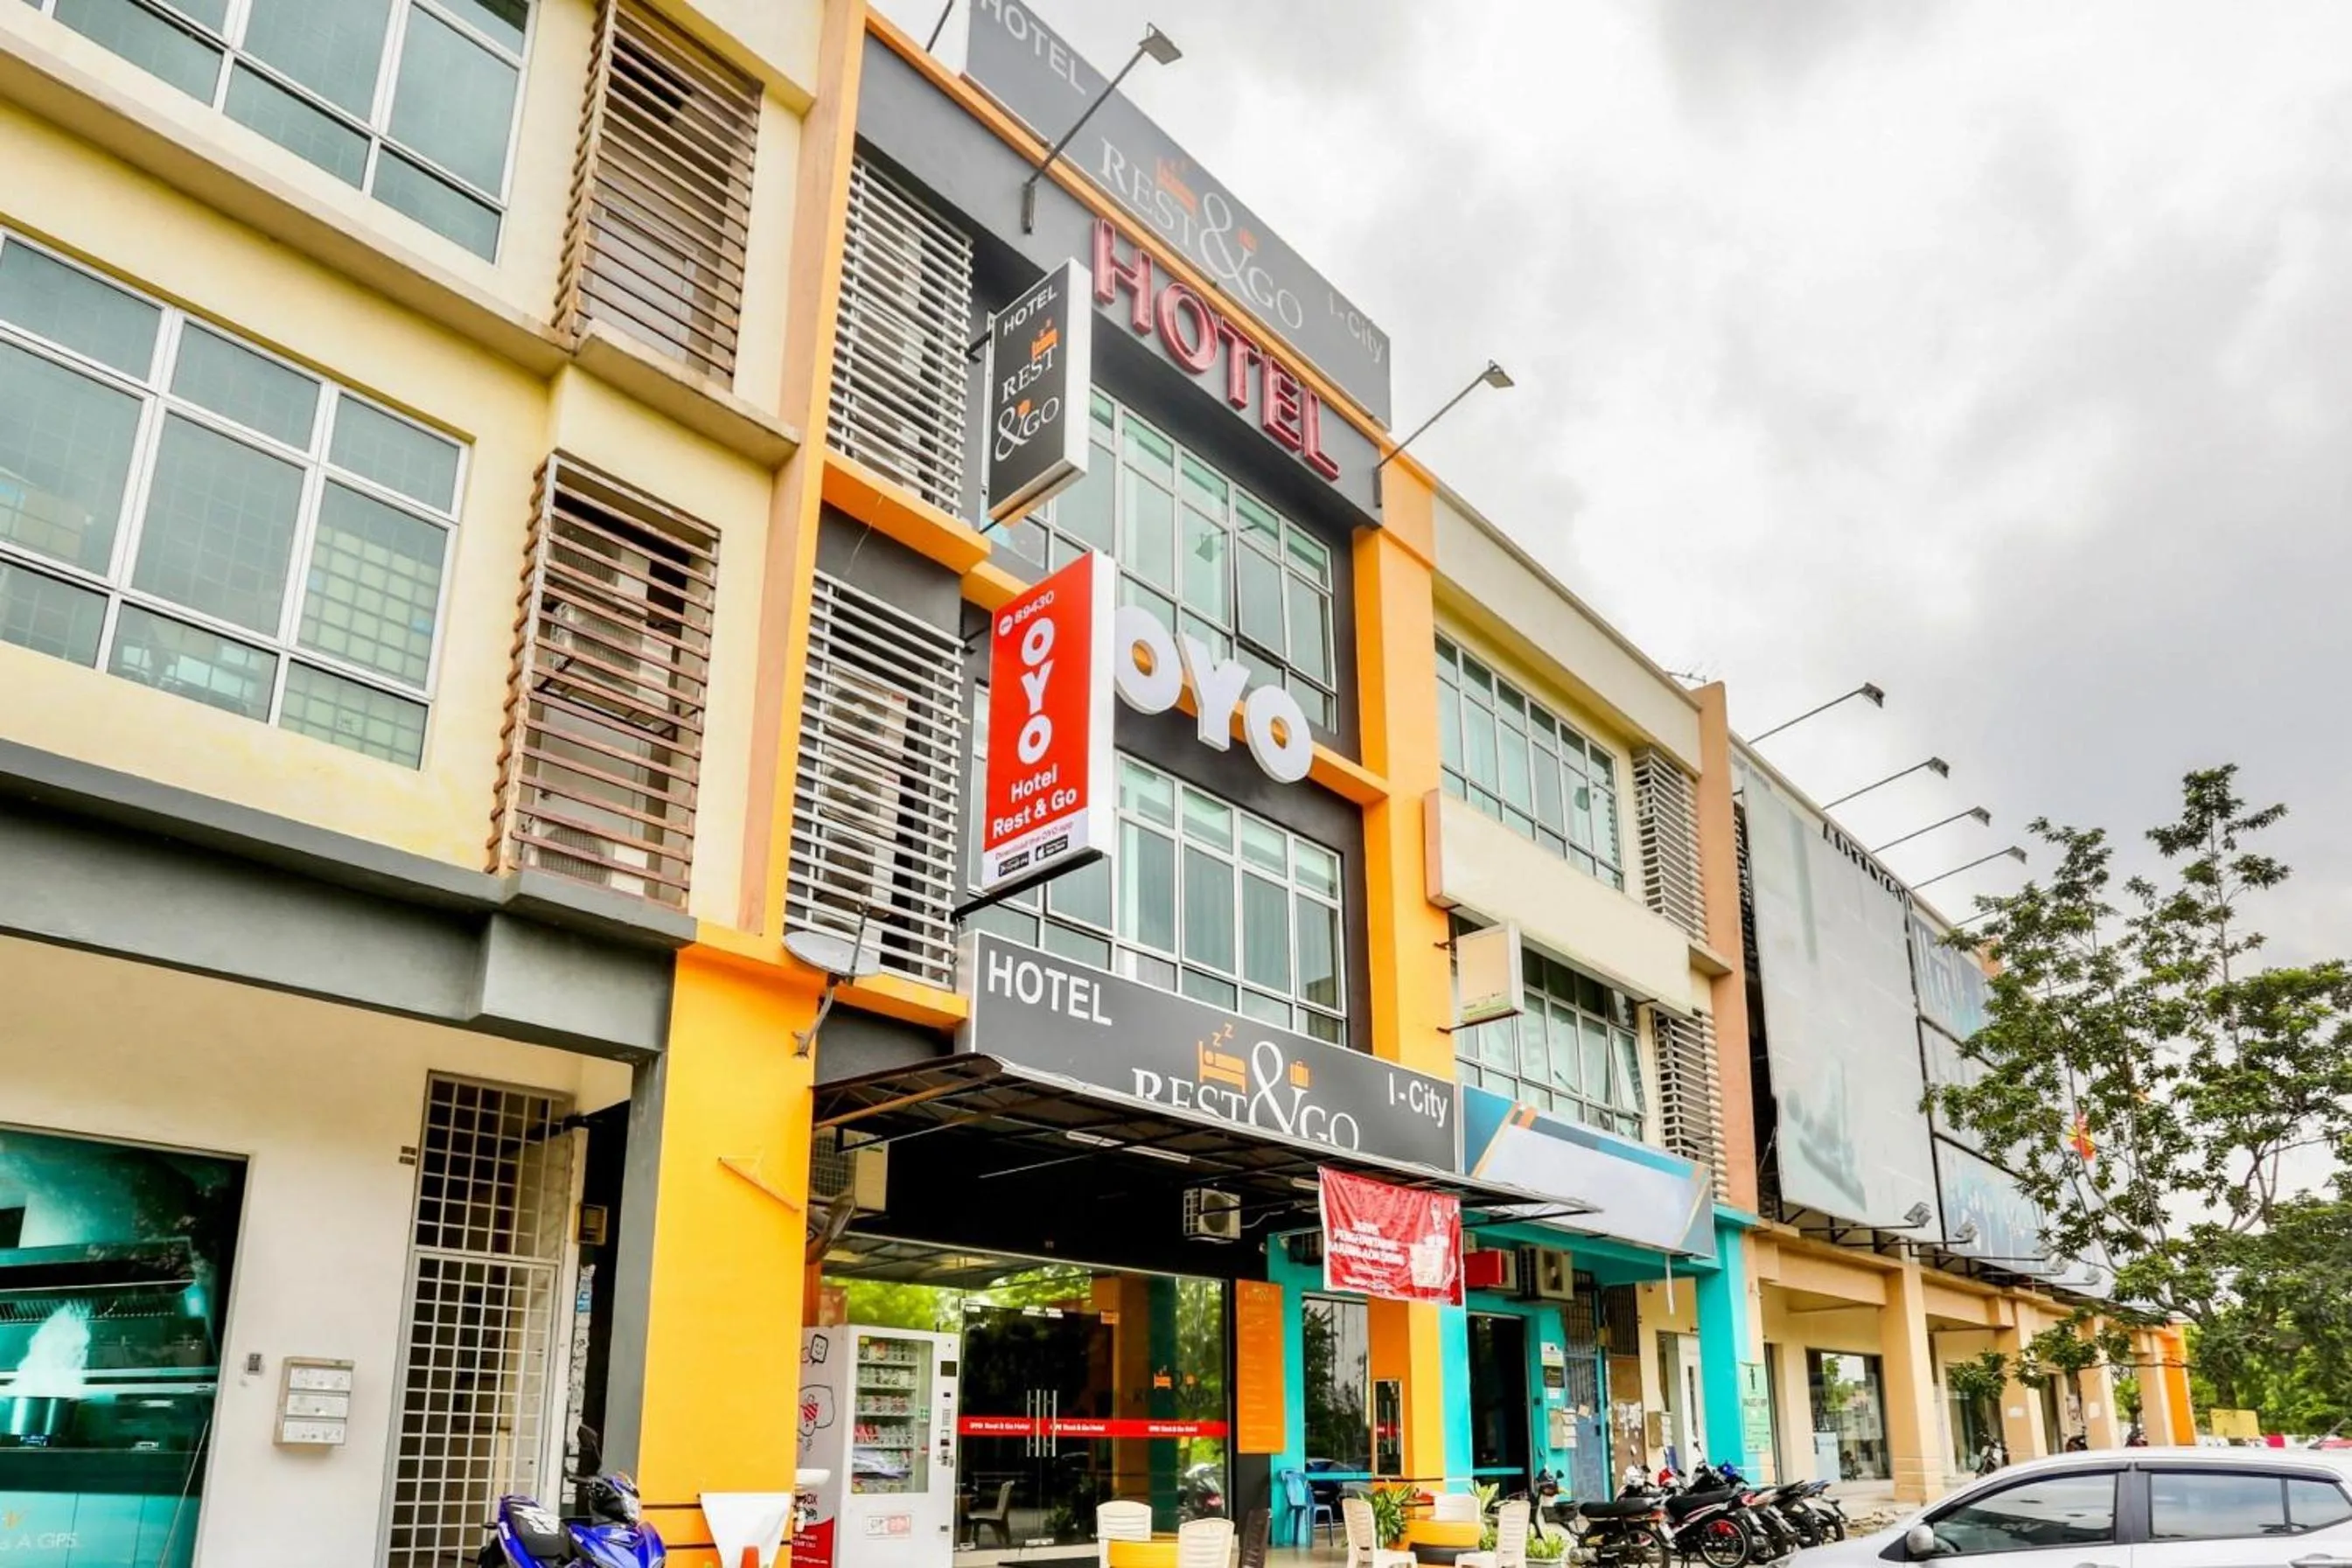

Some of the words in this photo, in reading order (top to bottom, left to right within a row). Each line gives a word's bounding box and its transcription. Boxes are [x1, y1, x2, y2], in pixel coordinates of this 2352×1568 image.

[1100, 137, 1198, 246] REST
[1003, 284, 1057, 336] HOTEL
[1001, 344, 1057, 404] REST
[1093, 218, 1340, 482] HOTEL
[1017, 617, 1055, 765] OYO
[1114, 604, 1314, 784] OYO
[993, 805, 1031, 840] Rest
[1034, 798, 1047, 819] &
[1050, 788, 1077, 812] Go
[1010, 763, 1057, 804] Hotel
[988, 950, 1113, 1026] HOTEL
